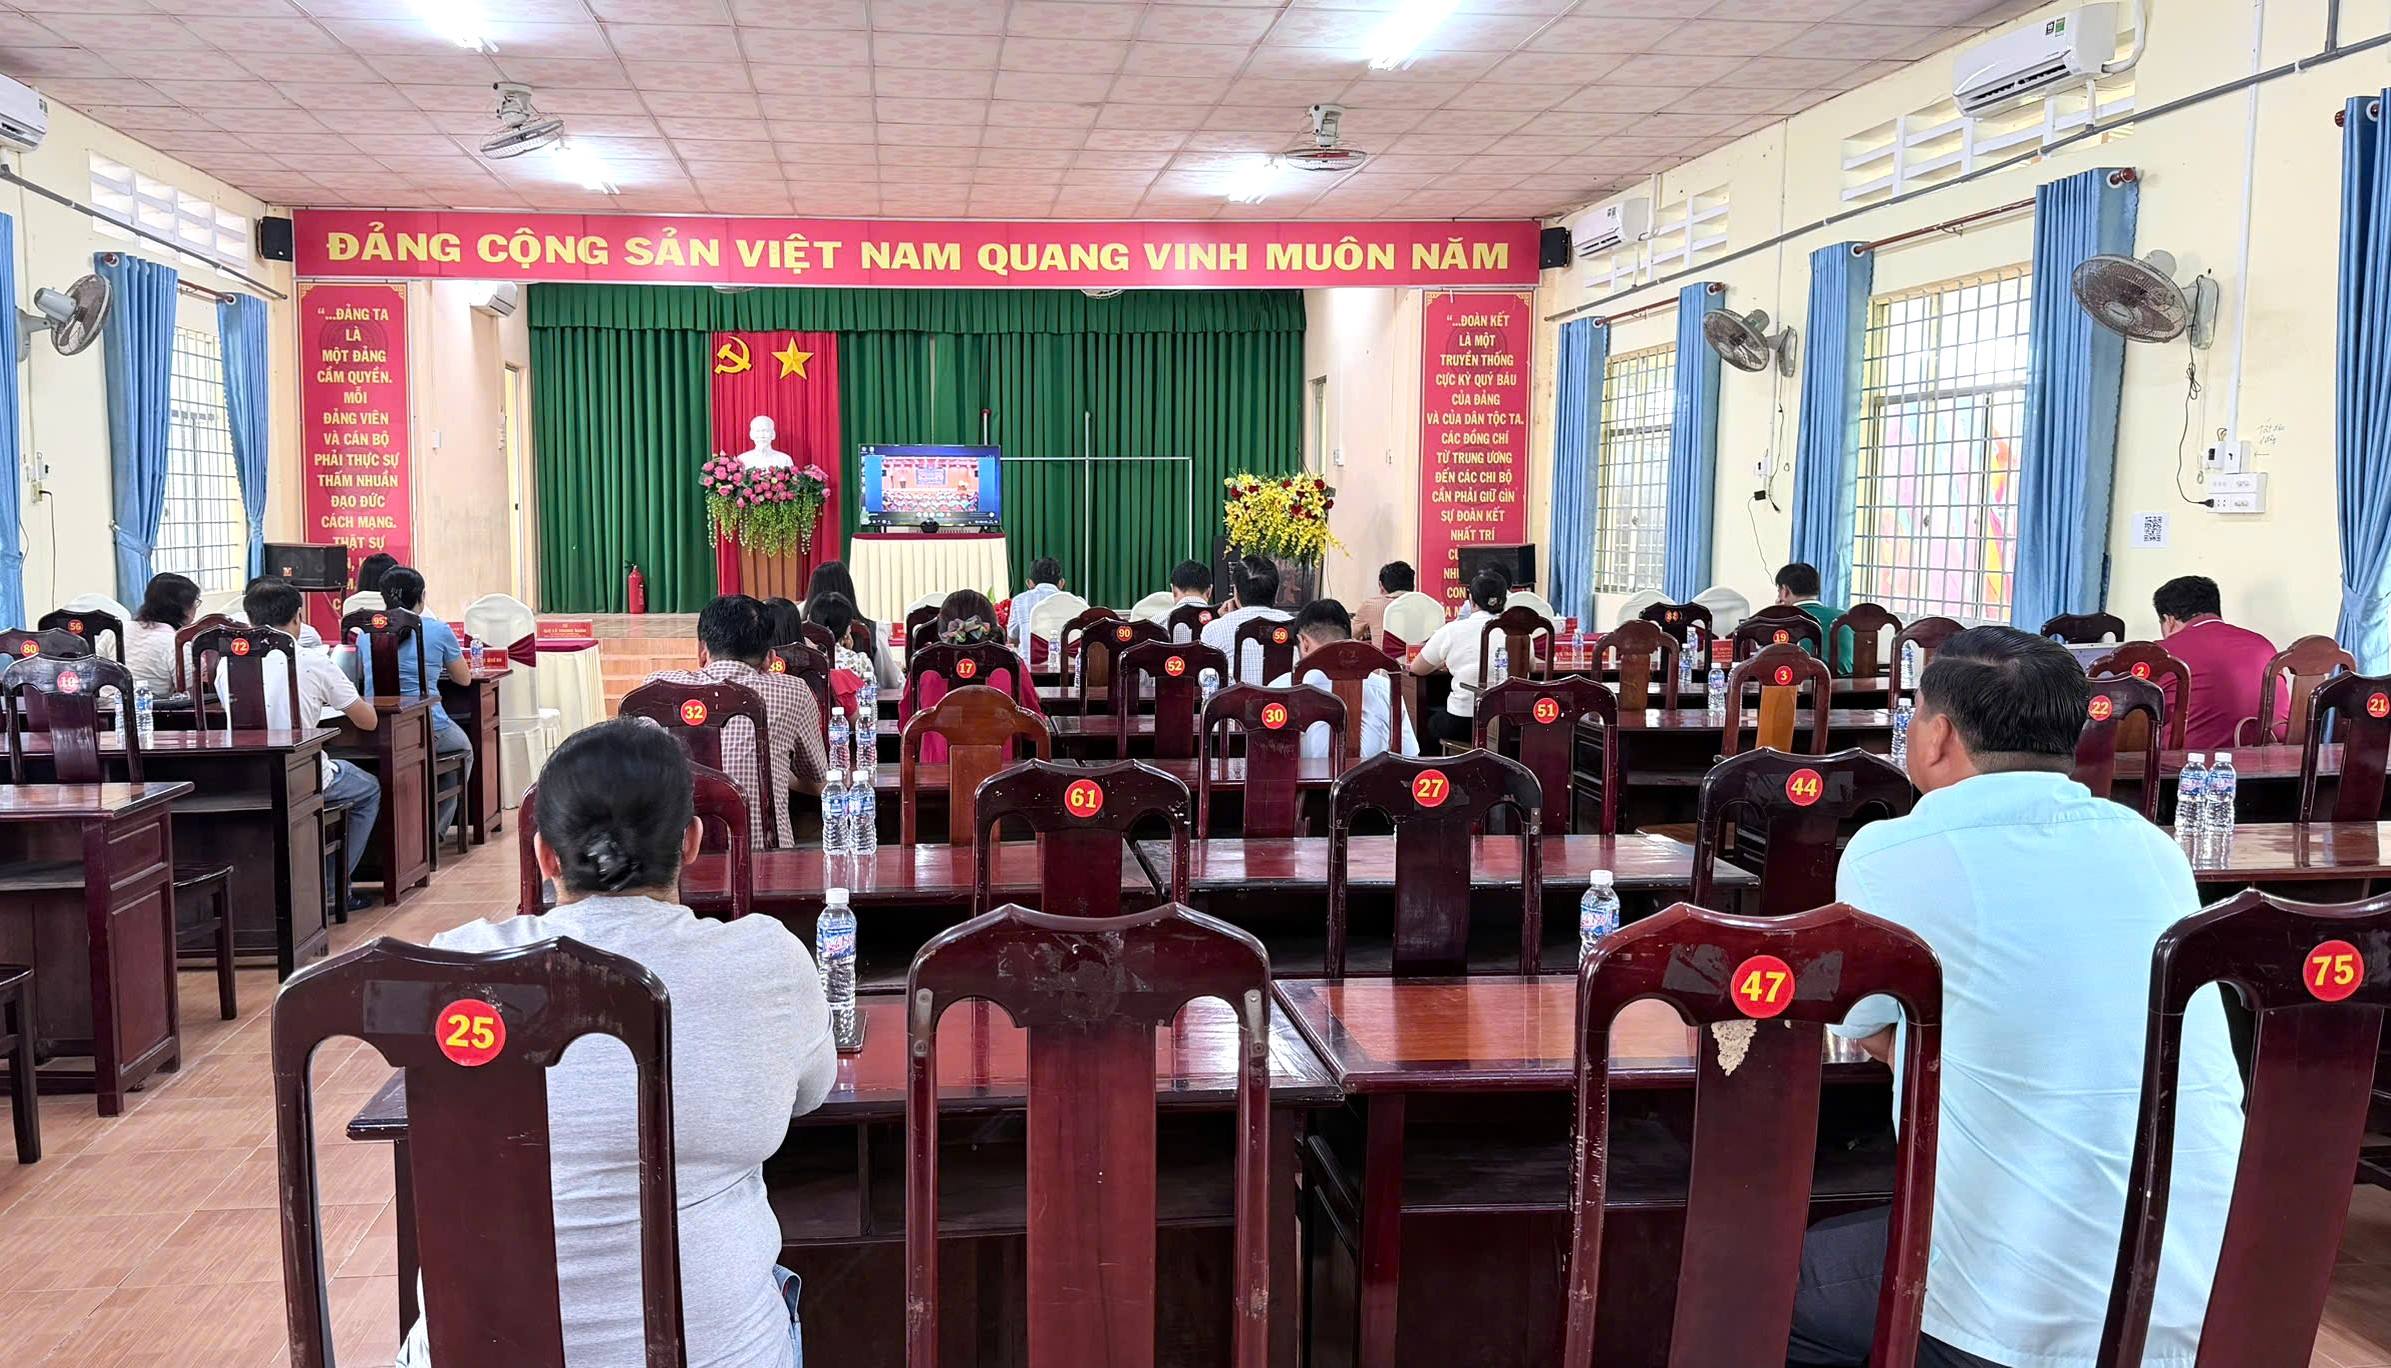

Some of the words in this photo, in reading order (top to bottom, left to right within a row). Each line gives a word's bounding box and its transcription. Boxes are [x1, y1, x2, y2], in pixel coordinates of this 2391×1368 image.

[326, 222, 461, 263] ĐẢNG
[477, 228, 609, 269] CỘNG
[624, 228, 720, 267] SẢN
[735, 233, 842, 274] VIỆT
[861, 243, 961, 271] NAM
[977, 243, 1129, 276] QUANG
[1143, 243, 1248, 271] VINH
[1266, 236, 1396, 271] MUÔN
[1411, 237, 1509, 270] NĂM
[373, 308, 389, 320] TA
[1490, 310, 1510, 327] KẾT
[345, 326, 361, 341] LÀ
[1459, 332, 1471, 346] LÀ
[1474, 332, 1495, 348] MỘT
[322, 347, 349, 364] MỘT
[352, 345, 386, 362] ĐẢNG
[1440, 350, 1478, 366] TRUYỀN
[1481, 350, 1514, 366] THỐNG
[317, 365, 344, 383] CẦM
[348, 365, 392, 384] QUYỀN.
[1436, 372, 1456, 387] CỰC
[1474, 371, 1494, 387] QUÝ
[344, 386, 368, 404] MỖI
[1452, 389, 1471, 405] CỦA
[1474, 389, 1500, 405] ĐẢNG
[323, 408, 357, 425] ĐẢNG
[360, 410, 389, 425] VIÊN
[1427, 410, 1439, 425] VÀ
[1442, 409, 1462, 425] CỦA
[1465, 410, 1484, 425] DÂN
[1487, 411, 1506, 427] TỘC
[324, 430, 339, 445] VÀ
[344, 430, 368, 445] CÁN
[372, 430, 389, 447] BỘ
[1441, 430, 1460, 444] CÁC
[1463, 429, 1489, 444] ĐỒNG
[1492, 430, 1509, 444] CHÍ
[314, 449, 342, 466] PHẢI
[346, 453, 379, 469] THỰC
[383, 453, 399, 469] SỰ
[1436, 450, 1450, 464] TỪ
[1452, 452, 1484, 464] TRUNG
[1487, 451, 1512, 464] ƯƠNG
[317, 471, 352, 487] THẤM
[356, 468, 398, 487] NHUẦN
[1435, 467, 1456, 483] ĐẾN
[1458, 468, 1477, 483] CÁC
[1480, 471, 1496, 483] CHI
[1499, 469, 1512, 485] BỘ
[331, 495, 356, 510] ĐẠO
[360, 493, 385, 508] ĐỨC
[1432, 487, 1451, 503] CẦN
[1455, 487, 1477, 503] PHẢI
[1480, 488, 1497, 503] GIỮ
[1499, 488, 1514, 503] GÌN
[321, 512, 354, 528] CÁCH
[1441, 509, 1454, 523] SỰ
[1457, 507, 1483, 522] ĐOÀN
[1486, 506, 1505, 522] KẾT
[1450, 525, 1476, 540] NHẤT
[1479, 526, 1495, 540] TRÍ
[369, 535, 385, 551] SỰ
[1447, 587, 1466, 599] CON
[70, 623, 82, 631] 56
[1119, 629, 1131, 637] 90
[1274, 631, 1286, 639] 59
[1775, 633, 1787, 642] 19
[24, 646, 37, 654] 80
[233, 642, 247, 650] 72
[959, 663, 973, 673] 17
[1167, 661, 1182, 670] 52
[2137, 666, 2145, 677] 2
[1780, 670, 1788, 680] 3
[685, 706, 703, 719] 32
[1537, 704, 1554, 717] 51
[2092, 701, 2109, 715] 22
[2369, 698, 2386, 712] 21
[1265, 709, 1284, 722] 30
[1416, 778, 1443, 797] 27
[1791, 778, 1817, 796] 44
[1070, 788, 1096, 809] 61
[2312, 954, 2354, 986] 75
[1740, 970, 1787, 1003] 47
[445, 1014, 494, 1049] 25
